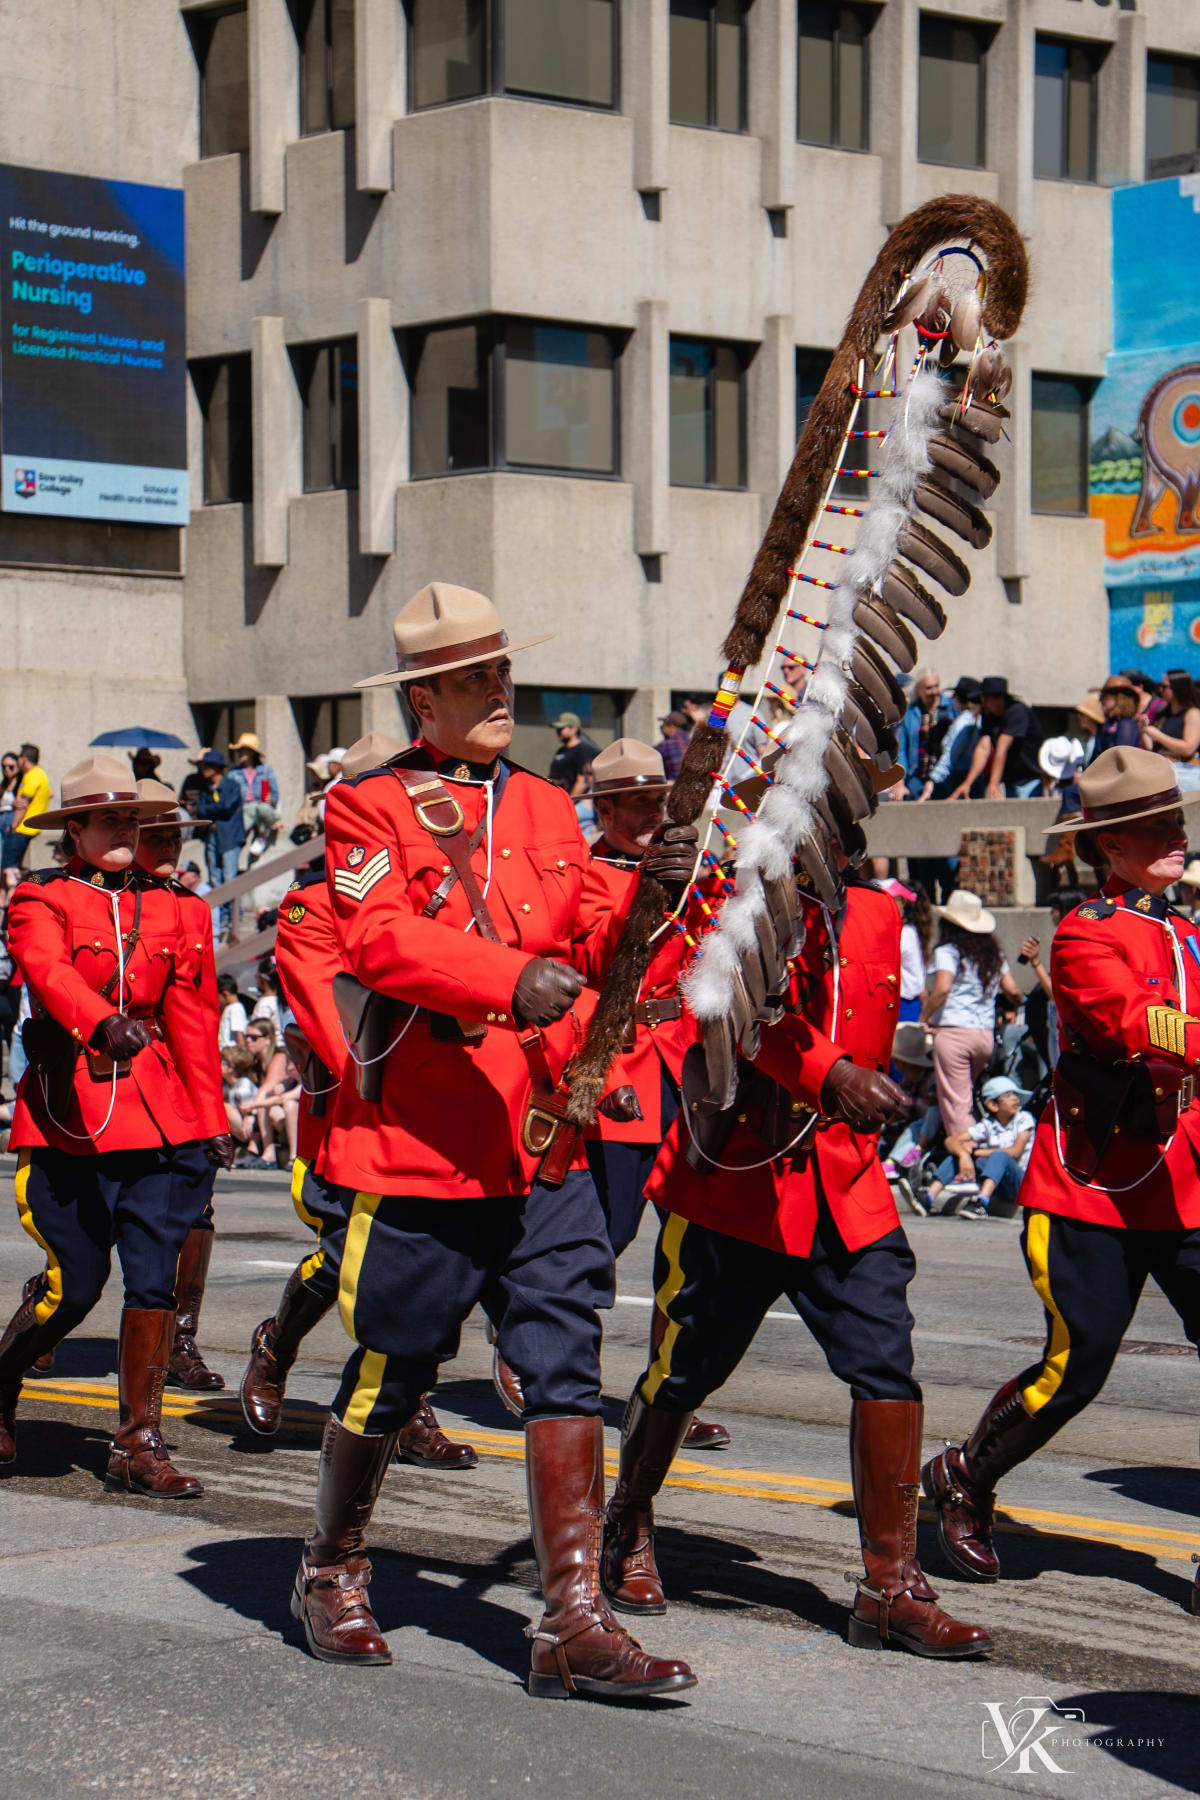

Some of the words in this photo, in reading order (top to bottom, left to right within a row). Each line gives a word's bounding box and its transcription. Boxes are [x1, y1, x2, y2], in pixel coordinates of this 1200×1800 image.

[9, 216, 26, 230] Hit
[27, 219, 48, 233] the
[49, 224, 91, 239] ground
[92, 230, 140, 249] working.
[11, 250, 147, 286] Perioperative
[12, 280, 93, 314] Nursing
[12, 322, 30, 338] for
[31, 325, 97, 345] Registered
[98, 333, 139, 350] Nurses
[140, 339, 165, 353] and
[12, 341, 67, 359] Licensed
[68, 347, 121, 365] Practical
[122, 353, 164, 370] Nurses
[39, 483, 72, 496] College
[58, 474, 84, 487] Valley
